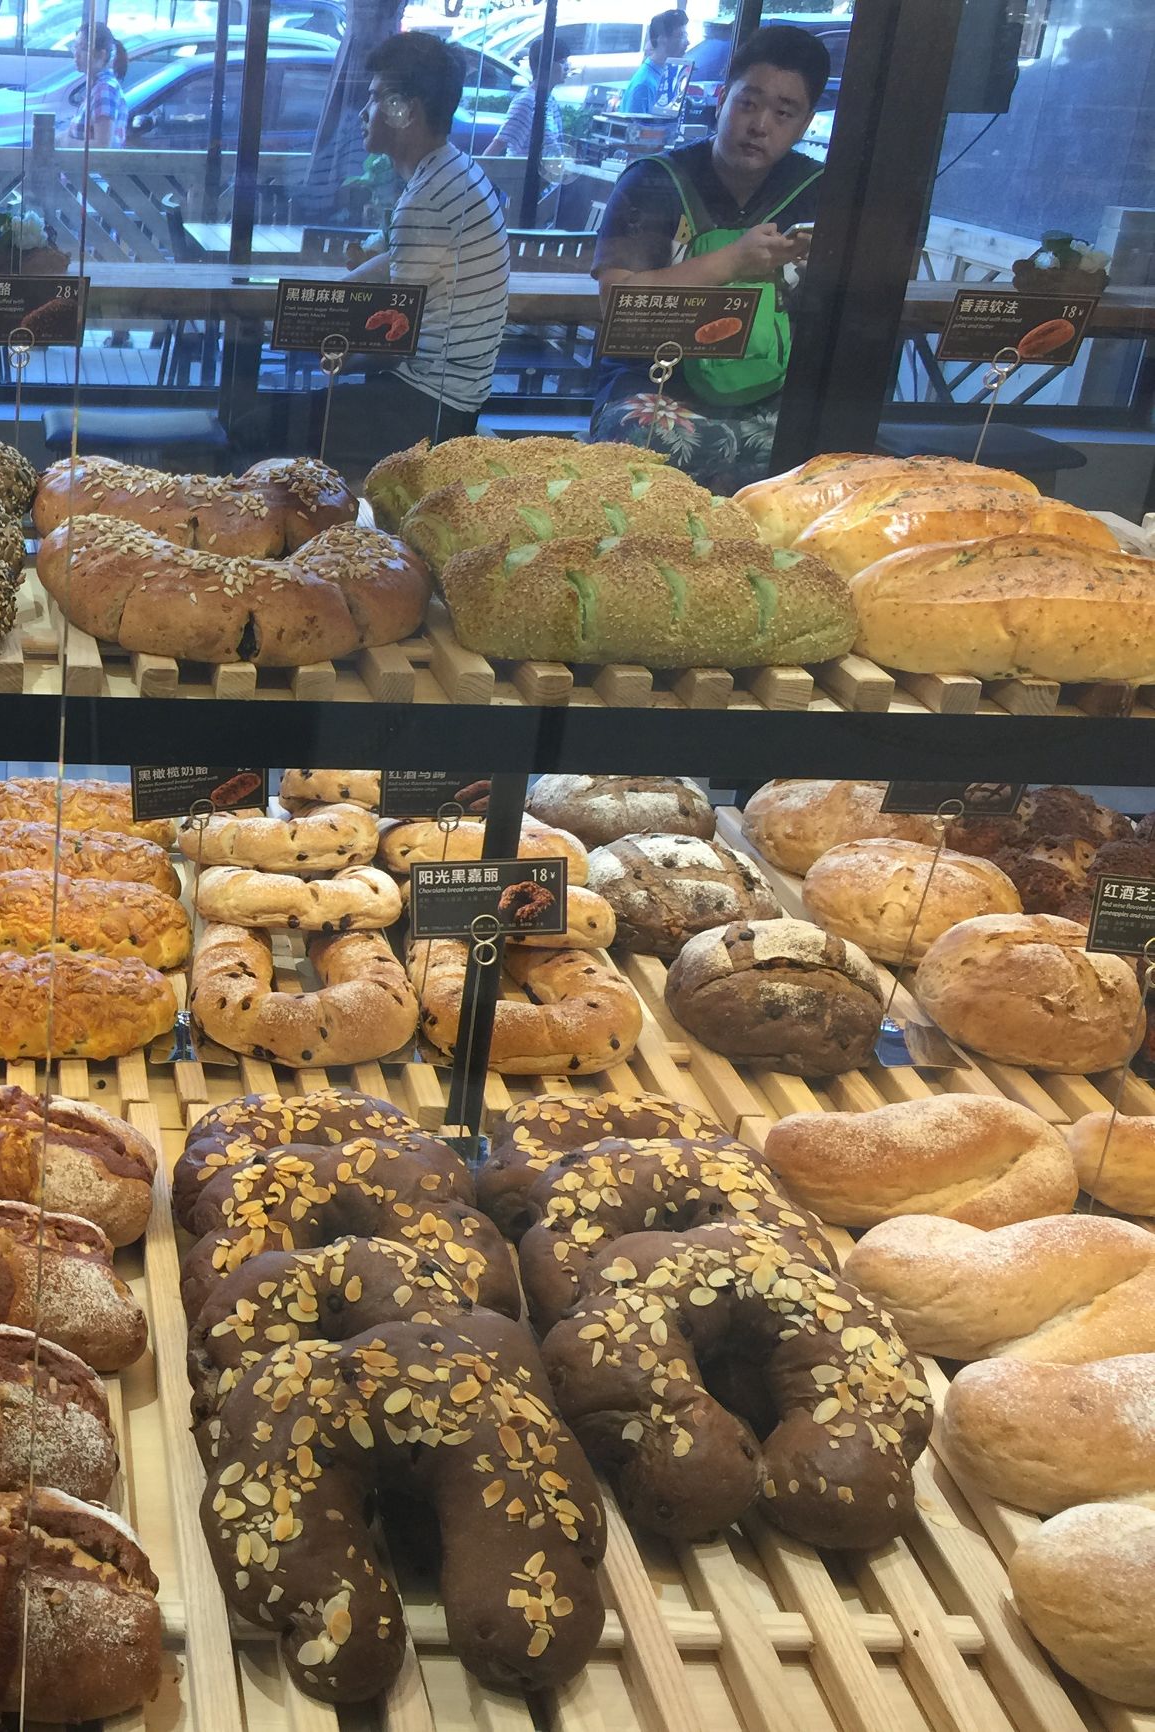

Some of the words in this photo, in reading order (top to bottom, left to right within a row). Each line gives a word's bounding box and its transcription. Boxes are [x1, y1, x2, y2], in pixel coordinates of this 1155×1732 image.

[349, 292, 373, 302] NEW
[617, 294, 680, 309] 抹茶凤梨
[683, 297, 707, 307] NEW
[959, 299, 1019, 315] 香蒜软法
[418, 868, 499, 885] 阳光黑嘉丽
